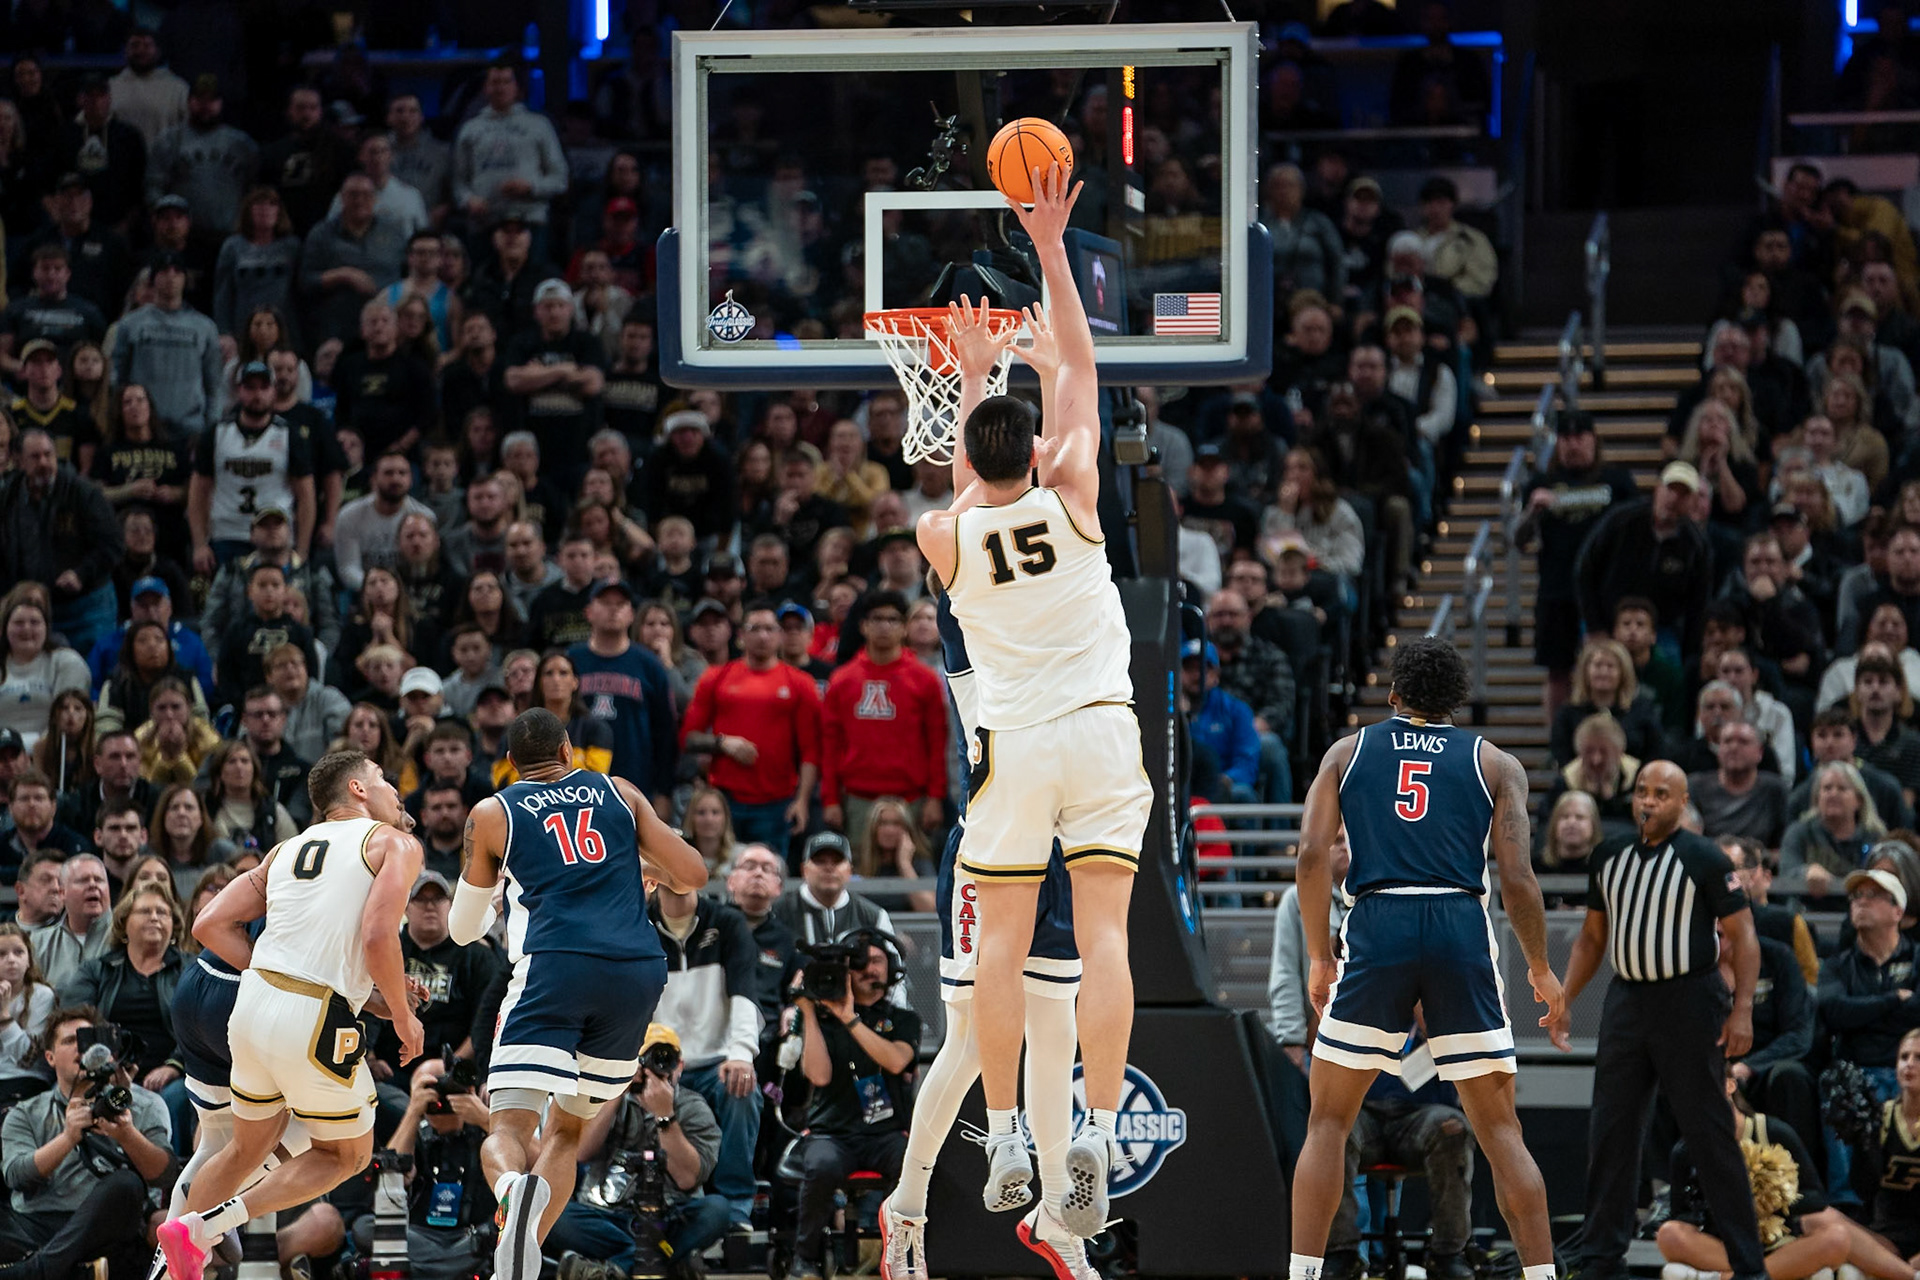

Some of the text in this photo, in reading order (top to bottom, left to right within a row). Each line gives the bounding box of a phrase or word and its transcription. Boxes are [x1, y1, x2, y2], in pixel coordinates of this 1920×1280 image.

[239, 486, 256, 514] 3
[981, 519, 1057, 586] 15
[1391, 732, 1448, 754] LEWIS
[516, 785, 605, 819] JOHNSON
[1395, 759, 1433, 822] 5
[542, 806, 607, 866] 16
[290, 838, 330, 881] 0
[959, 883, 977, 954] CATS
[332, 1027, 361, 1065] P
